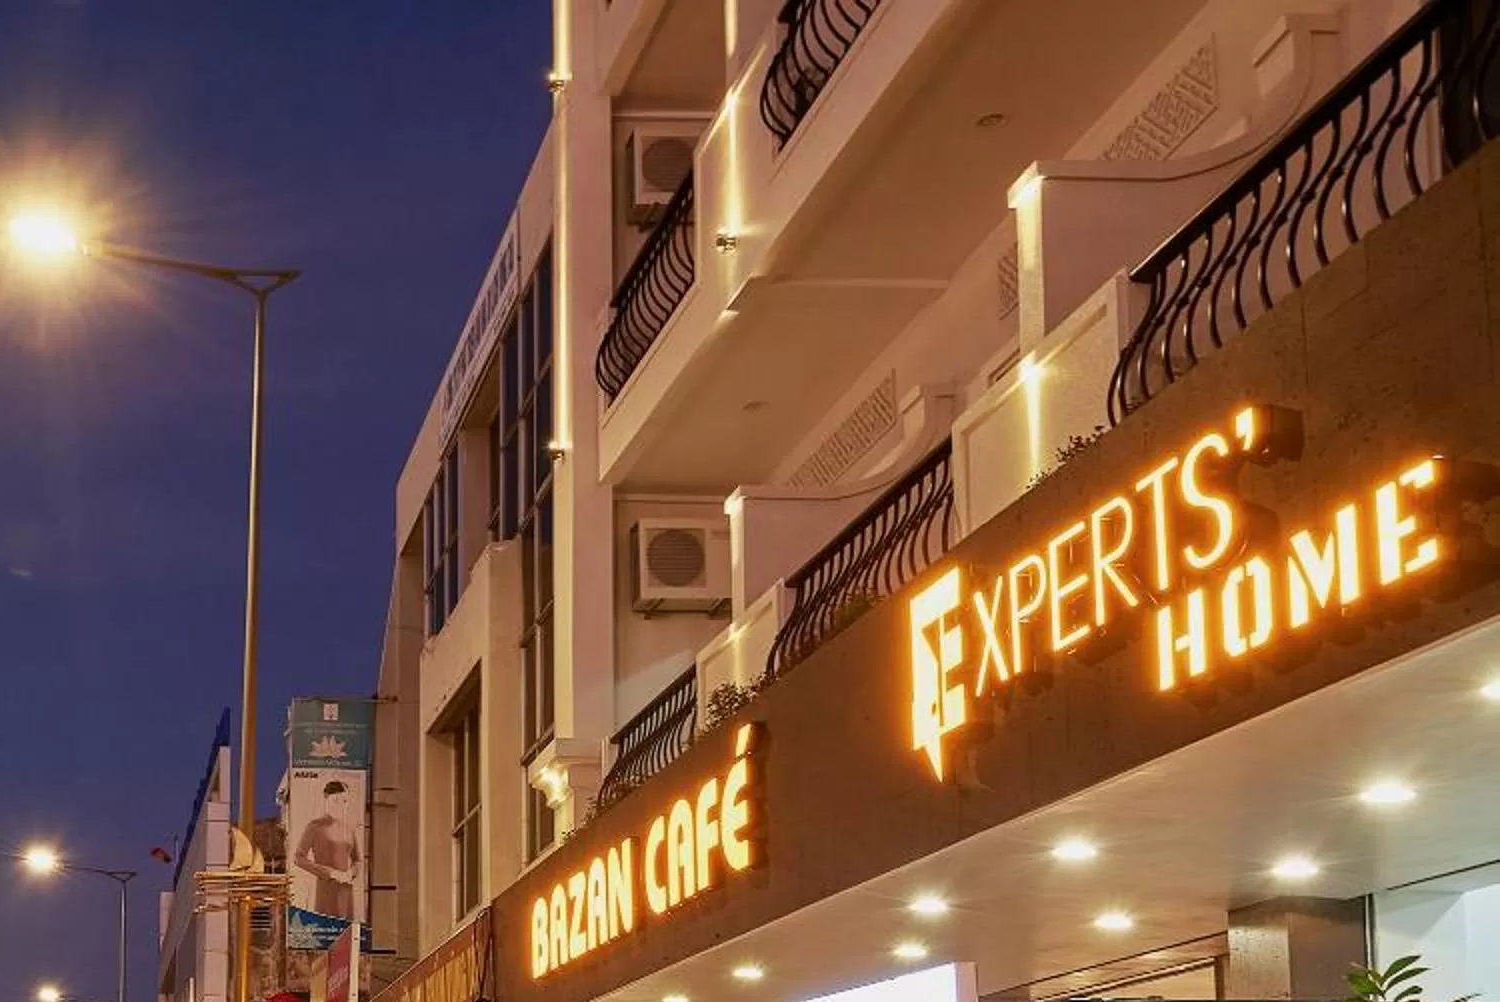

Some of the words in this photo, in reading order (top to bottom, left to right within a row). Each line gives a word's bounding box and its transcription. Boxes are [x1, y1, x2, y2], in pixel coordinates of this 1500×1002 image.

[1156, 458, 1440, 691] HOME
[530, 836, 634, 979] BAZAN
[643, 725, 752, 915] CAFÉ
